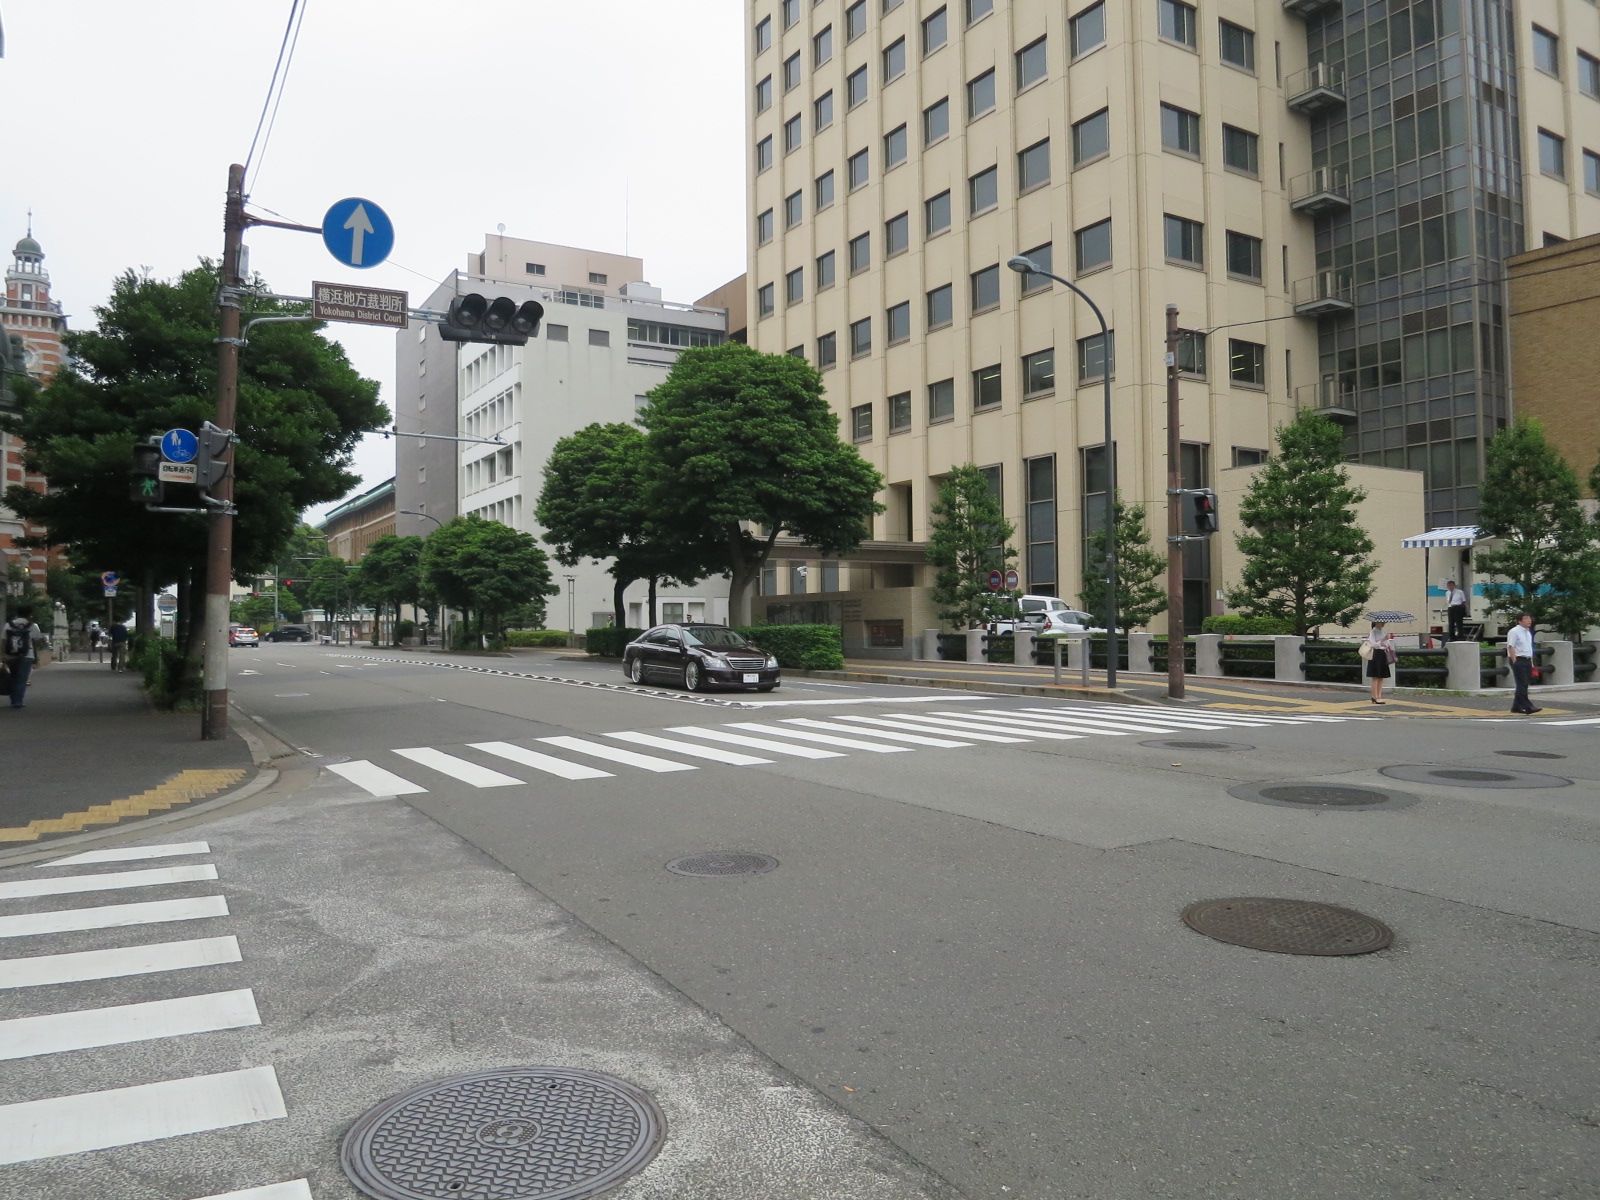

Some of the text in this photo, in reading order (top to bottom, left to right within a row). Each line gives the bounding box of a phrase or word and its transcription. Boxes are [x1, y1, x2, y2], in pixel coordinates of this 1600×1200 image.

[319, 288, 403, 312] 横浜地方裁判所
[320, 306, 402, 323] Yokohama District Court
